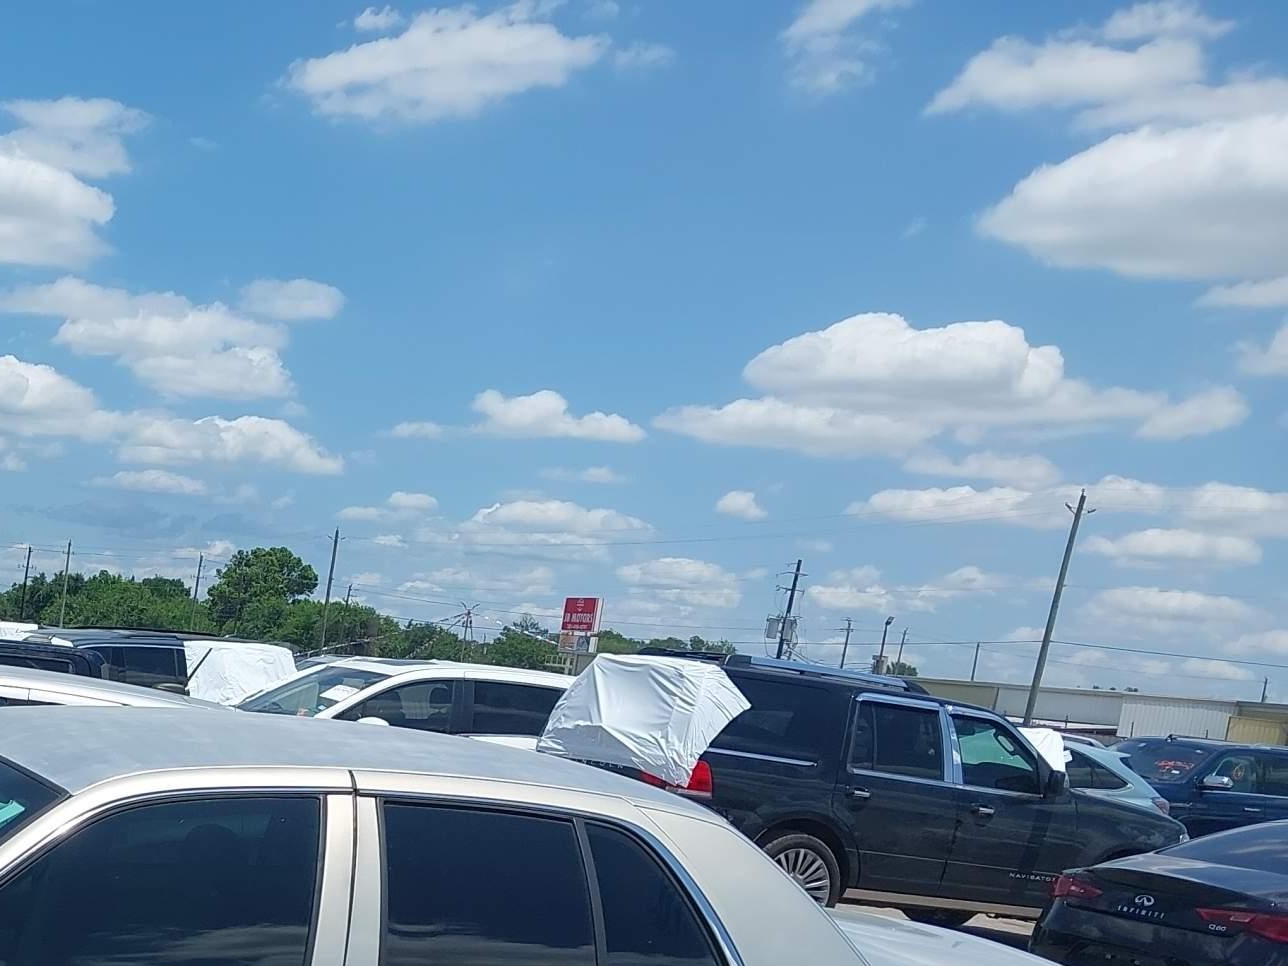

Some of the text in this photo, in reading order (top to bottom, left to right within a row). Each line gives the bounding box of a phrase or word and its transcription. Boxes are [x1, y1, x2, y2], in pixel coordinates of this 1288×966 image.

[571, 613, 593, 622] MOTORS
[1118, 905, 1165, 919] INFINITI
[1208, 923, 1227, 932] Q60
